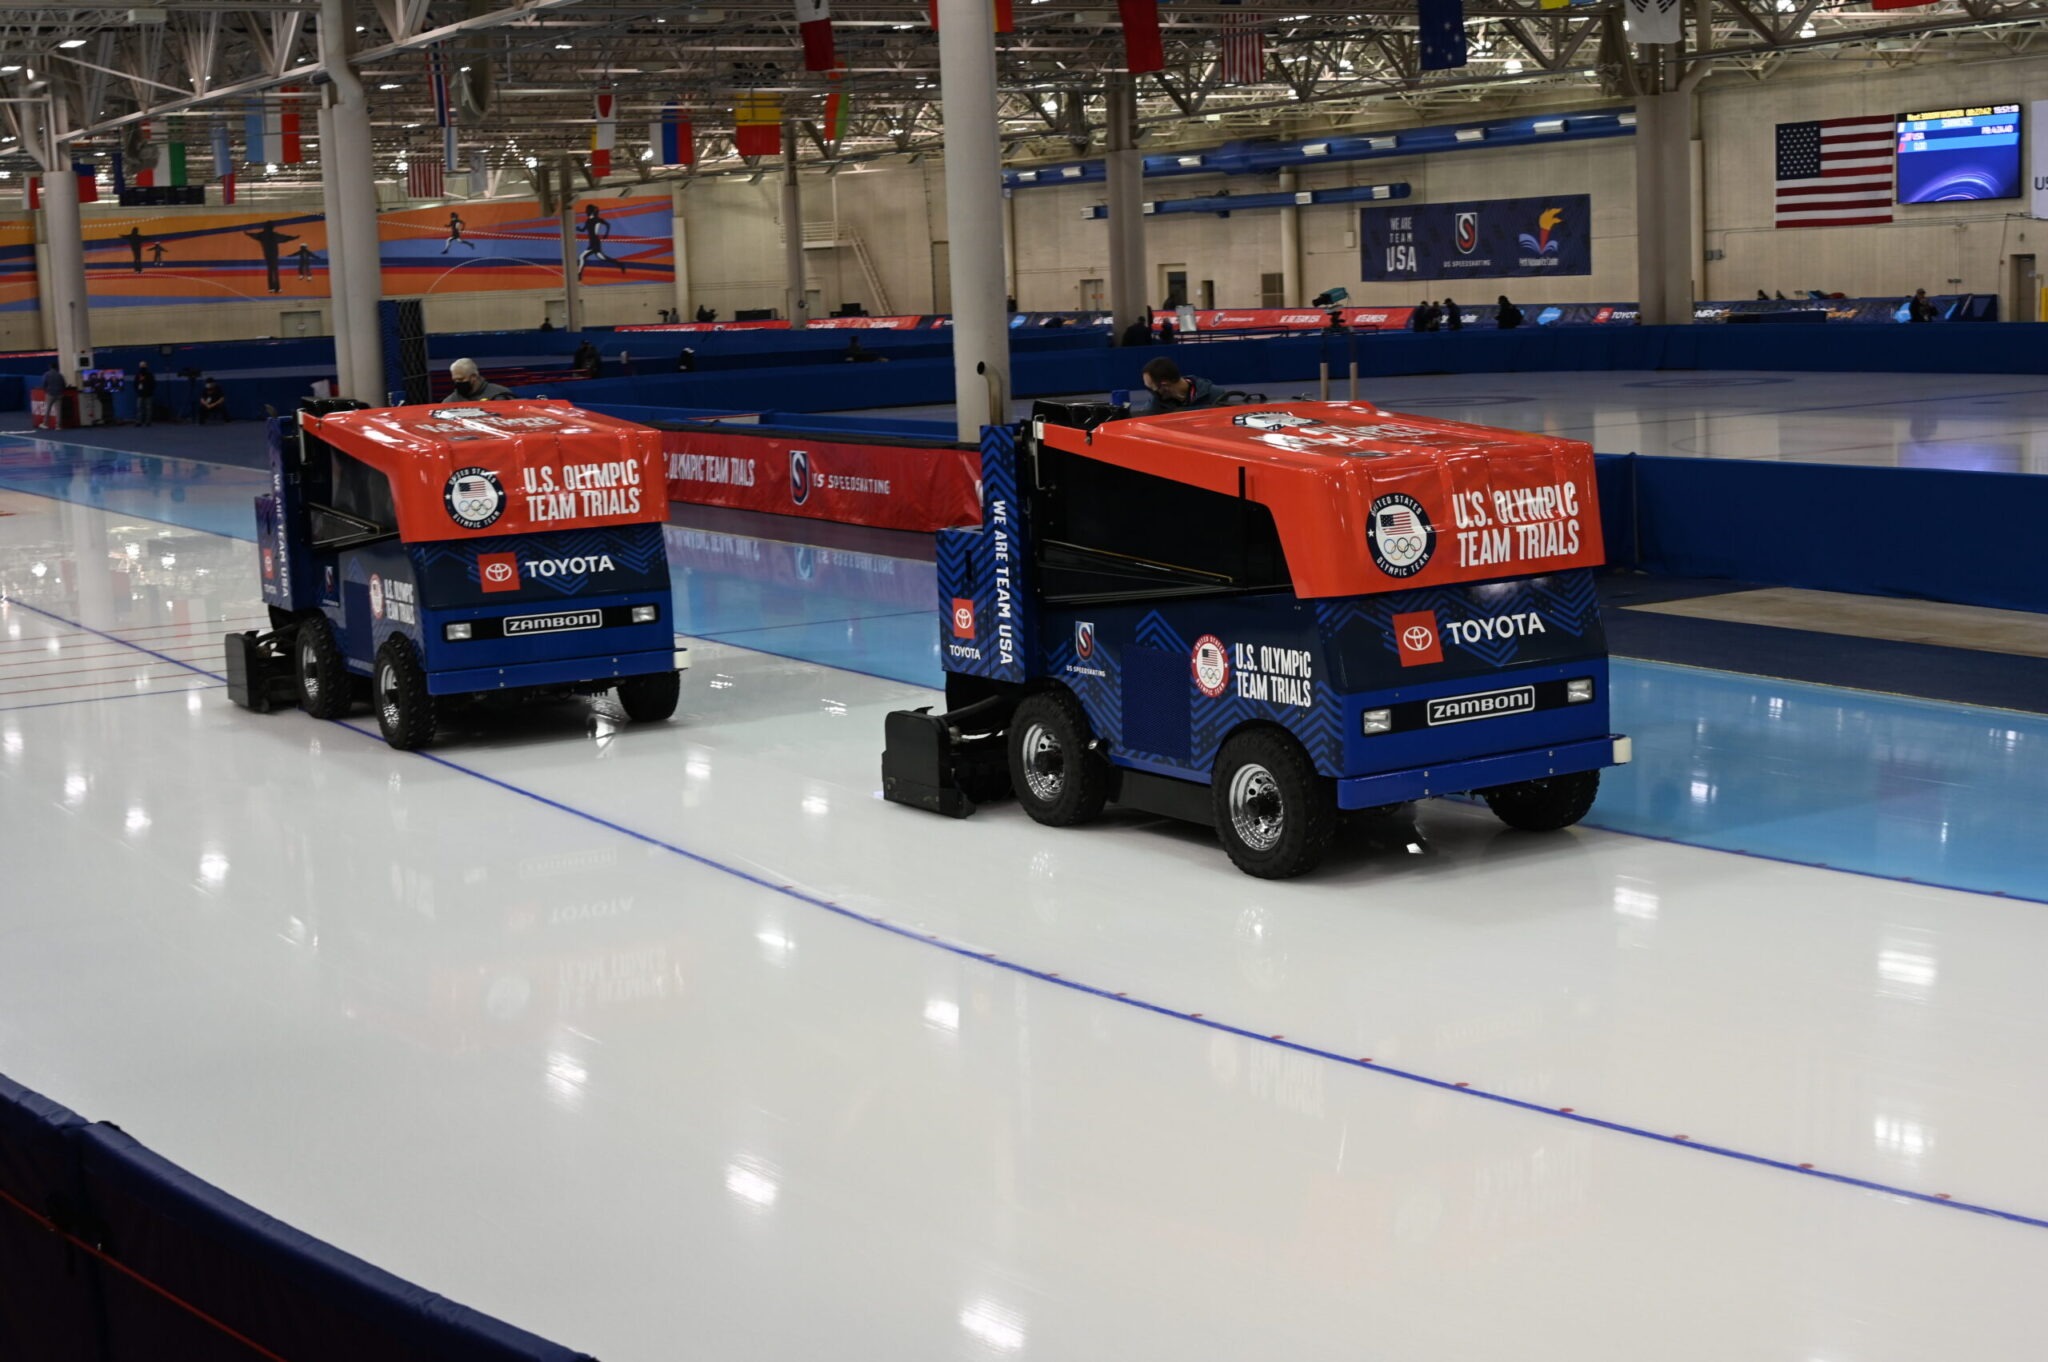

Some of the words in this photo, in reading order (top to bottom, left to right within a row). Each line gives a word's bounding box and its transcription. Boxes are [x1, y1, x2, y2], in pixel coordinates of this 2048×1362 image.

[1389, 232, 1413, 244] TEAM
[1386, 245, 1417, 272] USA
[272, 473, 281, 493] WE
[523, 465, 560, 494] U.S.
[562, 458, 640, 491] OLYMPIC
[705, 455, 729, 484] TEAM
[526, 492, 577, 522] TEAM
[580, 487, 640, 517] TRIALS
[992, 499, 1007, 525] WE
[1371, 496, 1392, 517] UNITED
[1394, 494, 1423, 515] STATES
[1452, 490, 1493, 529] U.S.
[1493, 481, 1579, 524] OLYMPIC
[276, 523, 286, 562] TEAM
[994, 529, 1009, 562] ARE
[1457, 527, 1511, 568] TEAM
[1516, 519, 1580, 560] TRIALS
[525, 555, 616, 578] TOYOTA
[1376, 556, 1408, 576] OLYMPIC
[1410, 552, 1430, 573] TEAM
[280, 566, 290, 598] USA
[995, 566, 1011, 618] TEAM
[509, 613, 597, 632] ZAMBONI
[1446, 611, 1546, 645] TOYOTA
[949, 644, 981, 660] TOYOTA
[998, 623, 1013, 664] USA
[1235, 643, 1258, 672] U.S.
[1260, 645, 1312, 679] OLYMPIC
[1235, 671, 1268, 701] TEAM
[1270, 674, 1312, 708] TRIALS
[1433, 691, 1530, 719] ZAMBONI
